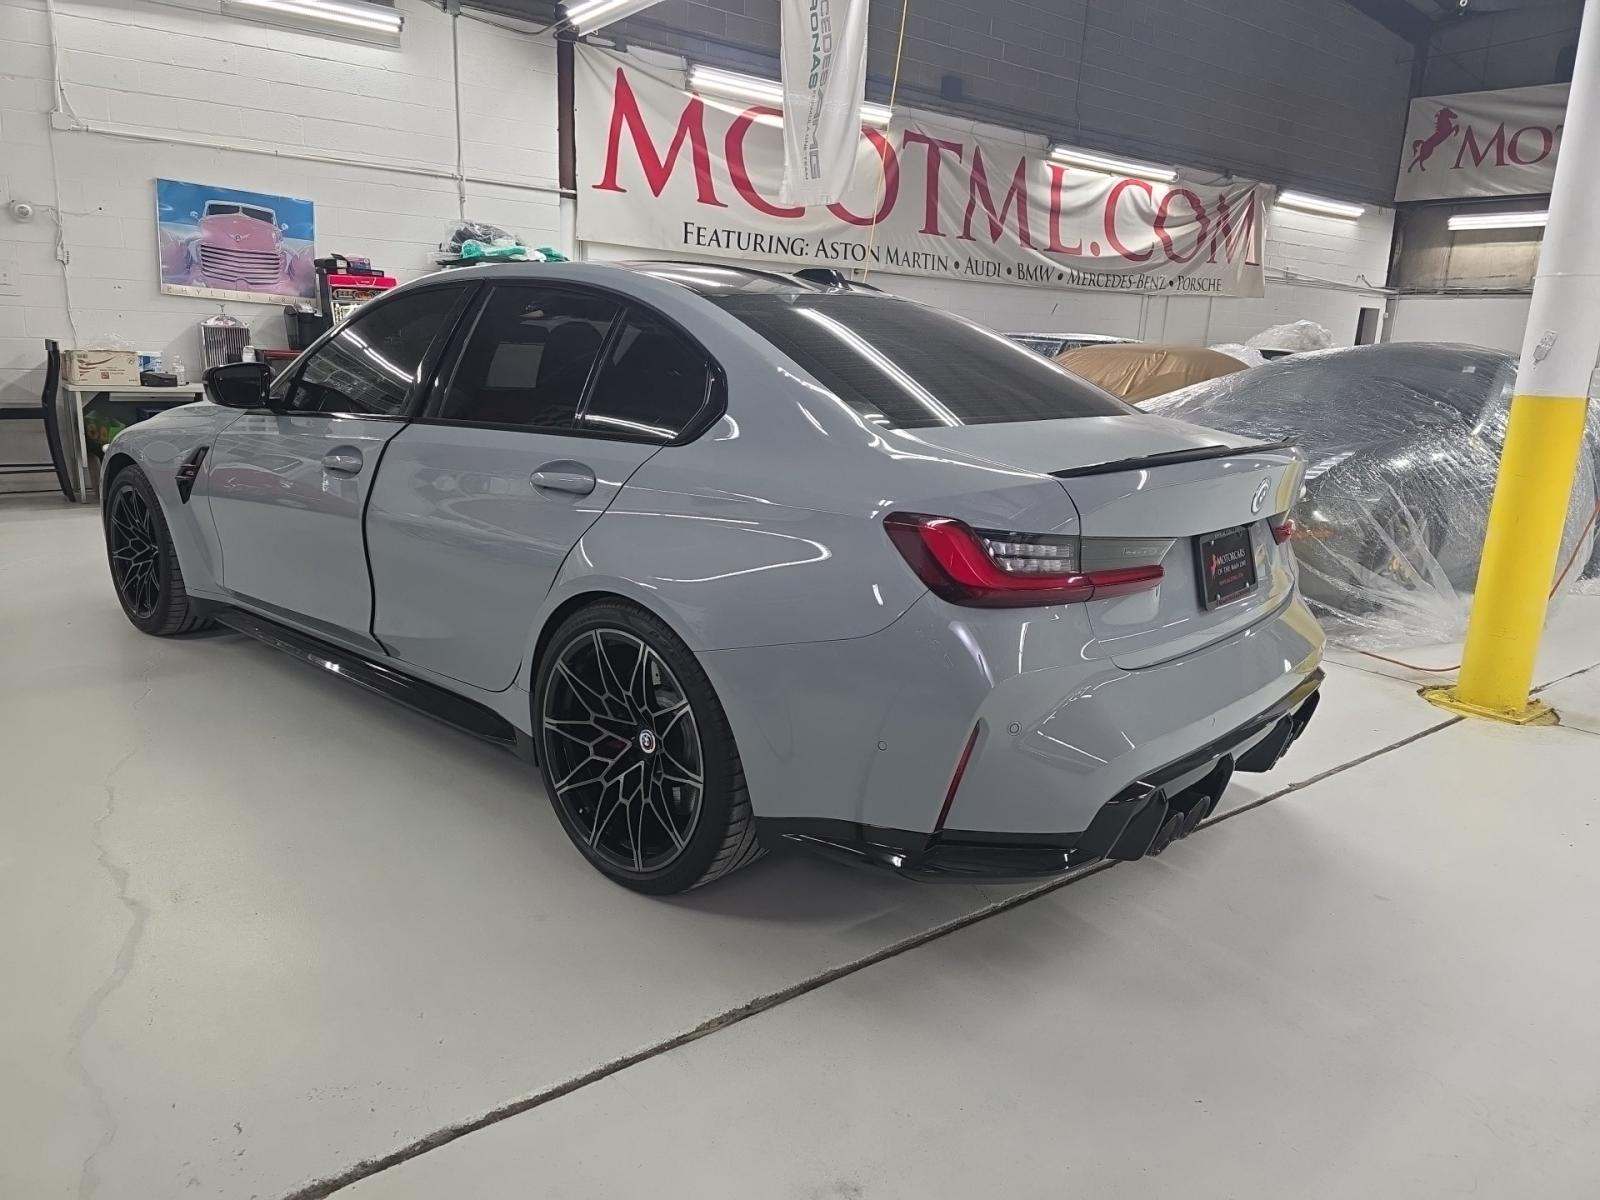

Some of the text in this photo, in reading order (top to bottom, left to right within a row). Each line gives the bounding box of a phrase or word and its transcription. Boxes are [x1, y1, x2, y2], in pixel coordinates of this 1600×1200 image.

[1450, 121, 1563, 170] MO
[683, 221, 1222, 292] FEATURING: ASTON MARTIN AUDI BMW MERCEDES-BENZ PORSCHE
[1217, 549, 1246, 564] MOTORCARS
